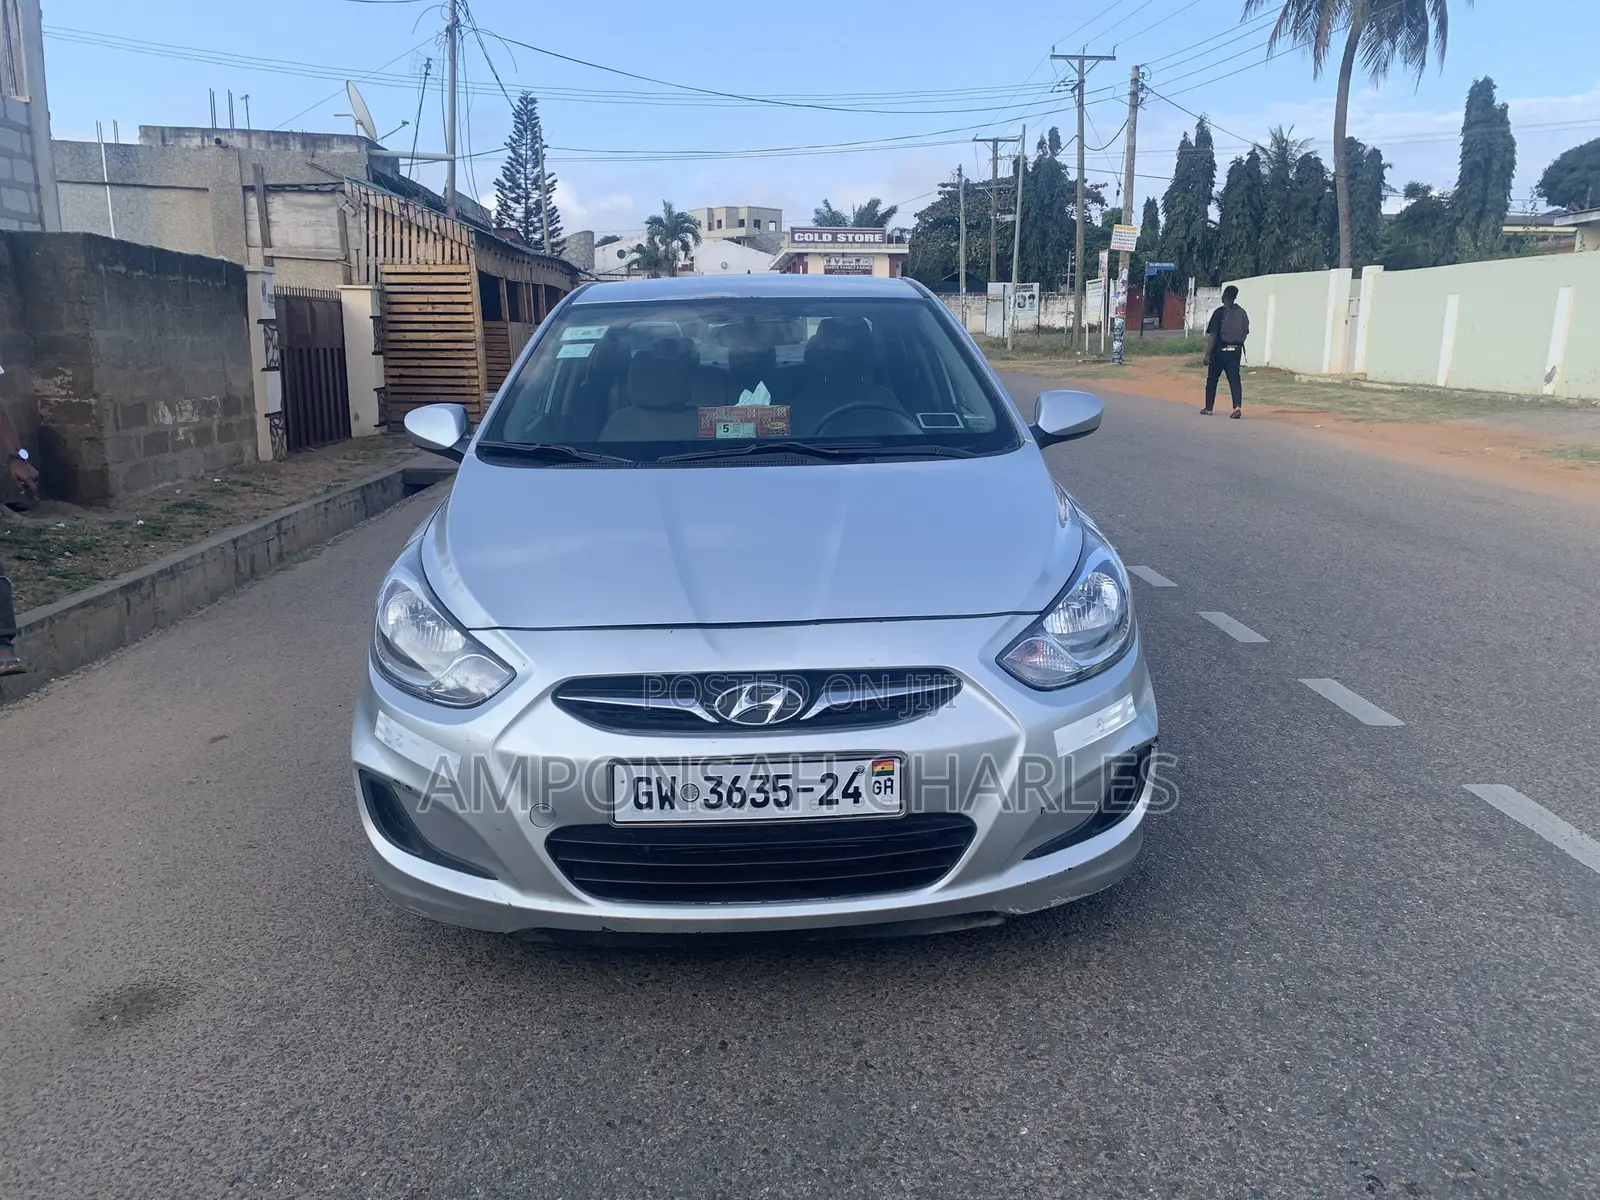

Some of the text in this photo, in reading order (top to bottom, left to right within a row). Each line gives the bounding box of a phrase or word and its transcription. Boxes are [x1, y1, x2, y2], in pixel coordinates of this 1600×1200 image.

[794, 233, 883, 242] COLD STORE
[723, 424, 729, 433] 5
[632, 771, 863, 810] GW 3635-24
[871, 778, 895, 797] GH
